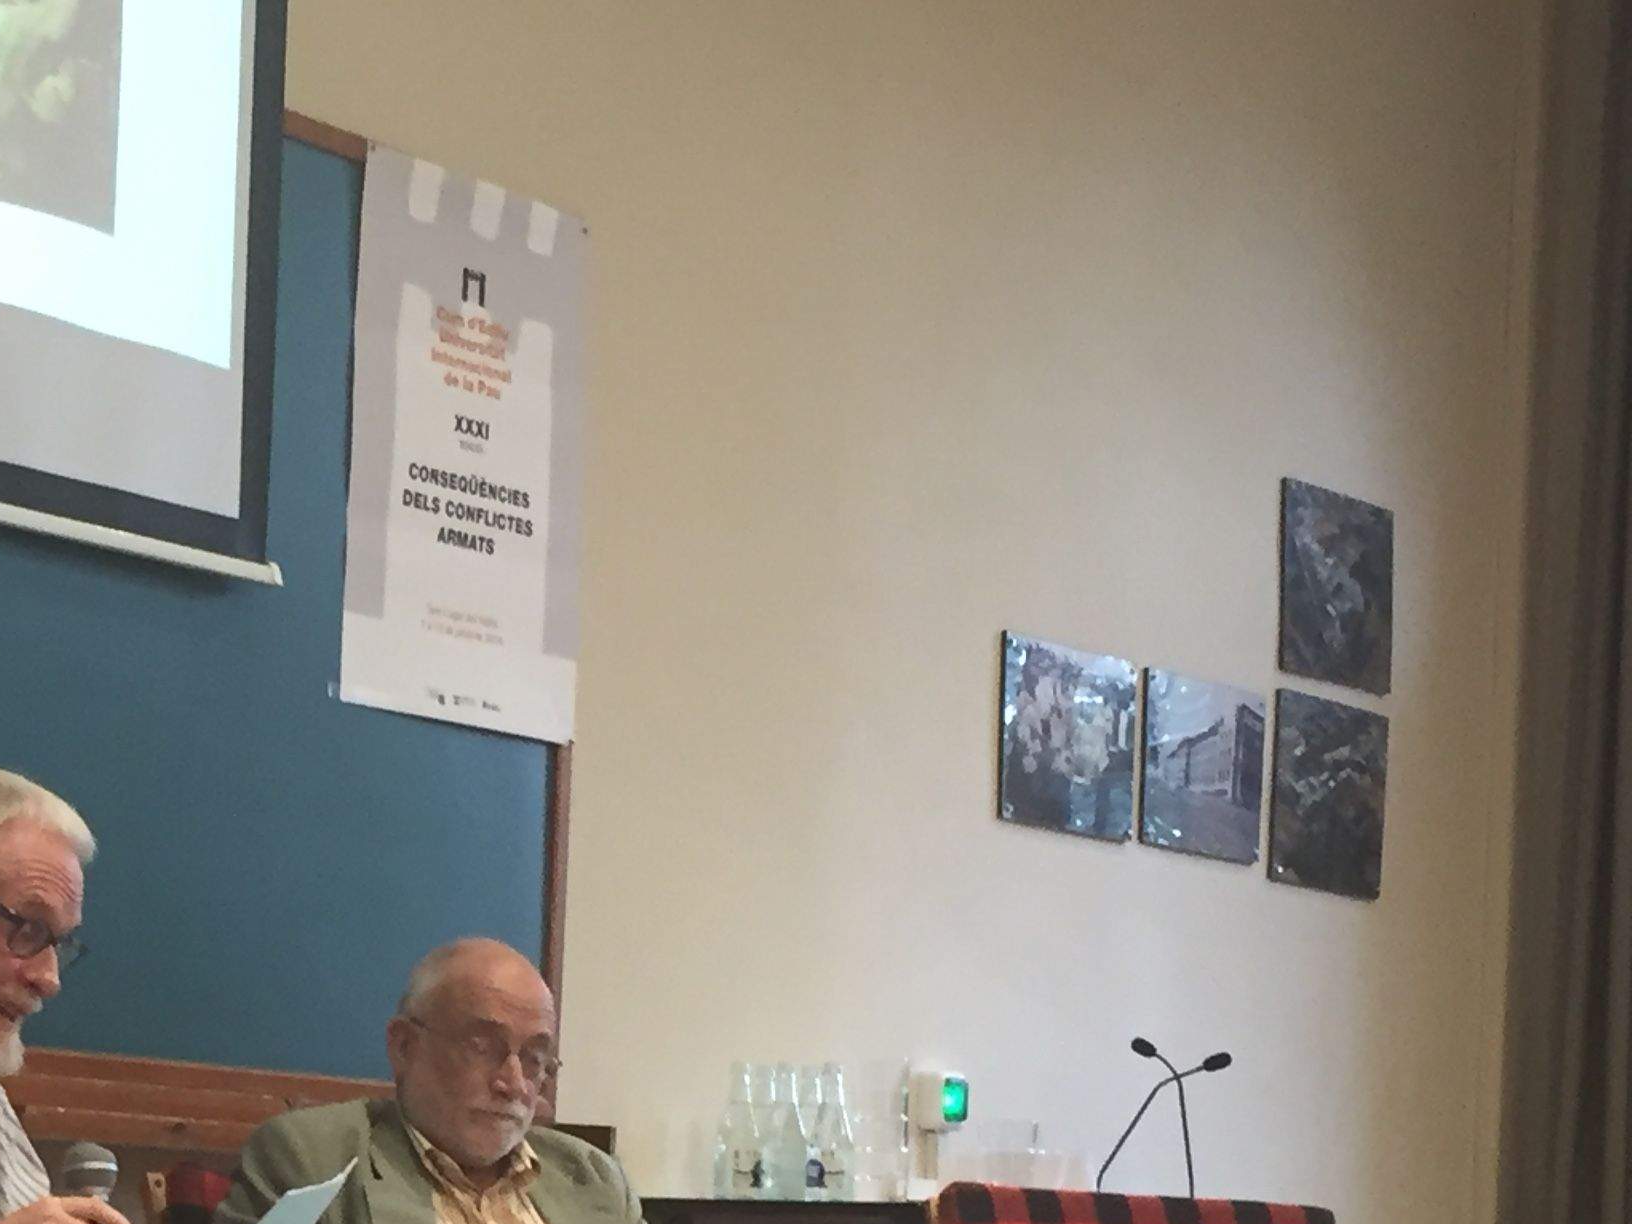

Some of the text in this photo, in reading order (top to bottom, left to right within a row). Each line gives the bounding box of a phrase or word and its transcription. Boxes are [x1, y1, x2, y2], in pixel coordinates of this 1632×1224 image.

[454, 414, 489, 440] XXXI
[402, 488, 533, 537] DELS CONFLICTES
[437, 527, 495, 555] ARMATS
